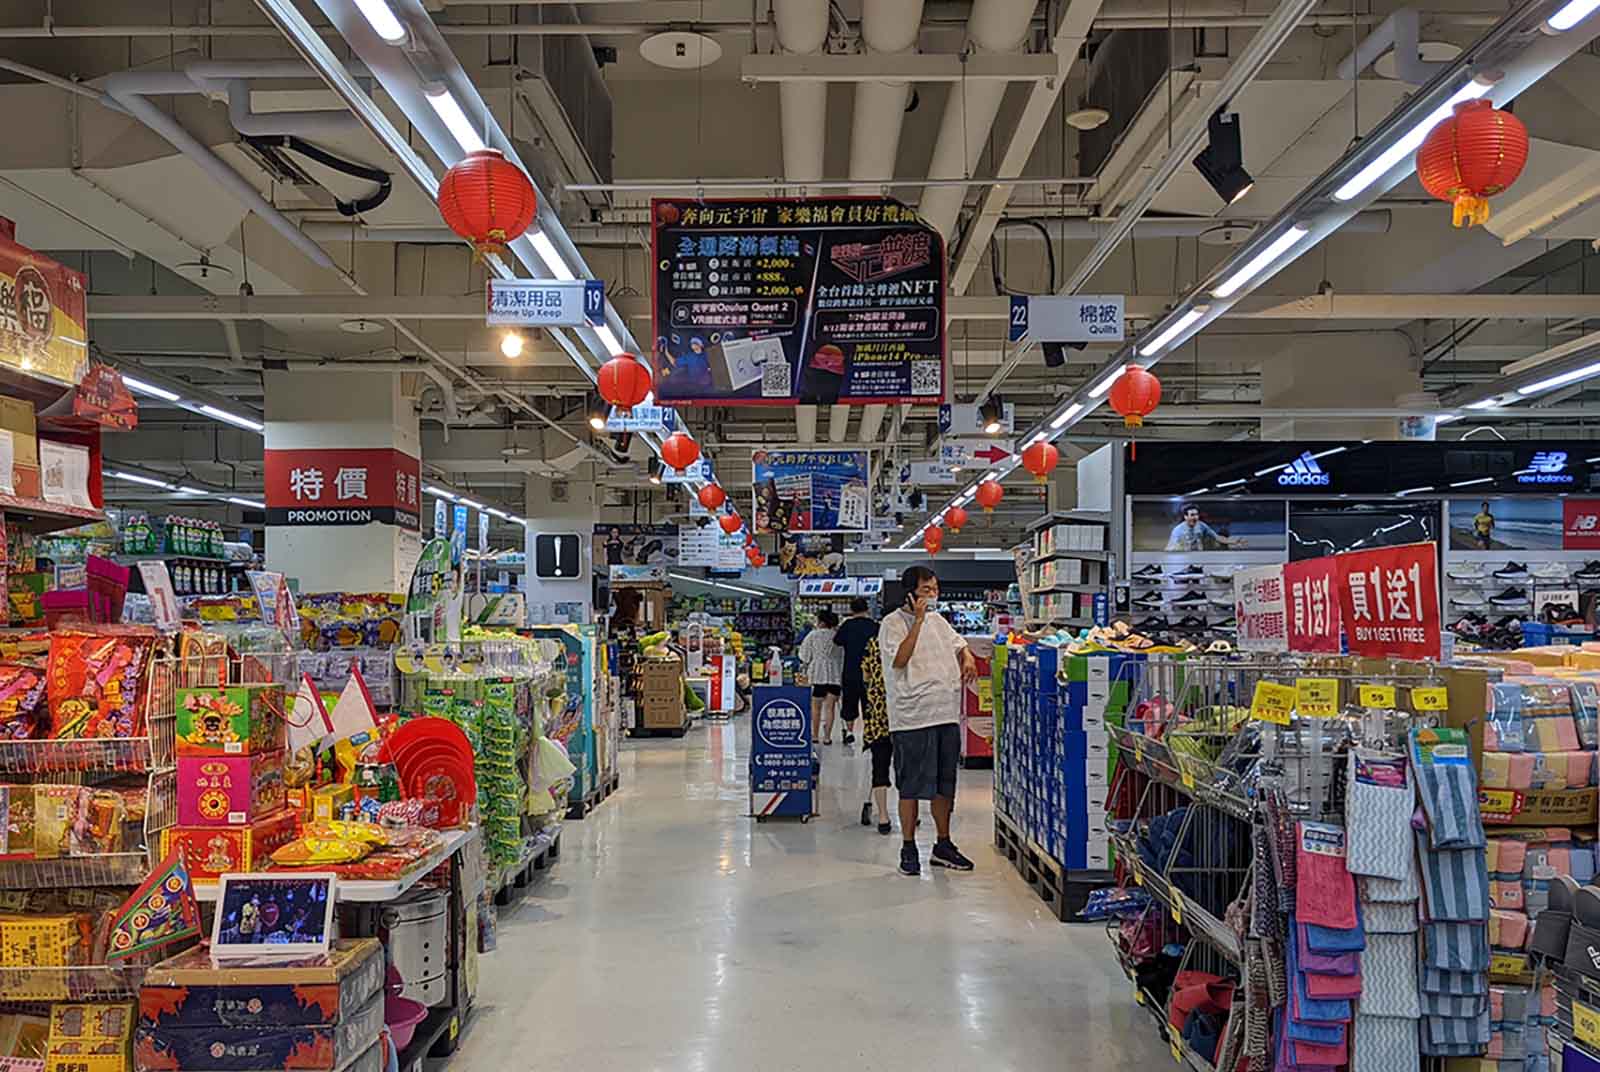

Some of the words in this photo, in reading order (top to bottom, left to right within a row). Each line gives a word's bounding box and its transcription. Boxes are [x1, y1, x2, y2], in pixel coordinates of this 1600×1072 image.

[681, 207, 768, 226] 奔向元宇宙
[491, 290, 562, 308] 清潔用品
[587, 290, 601, 311] 19
[782, 302, 789, 312] 2
[522, 309, 534, 318] Up
[537, 309, 562, 318] Keep
[1012, 306, 1027, 326] 22
[1079, 304, 1118, 324] 棉被
[1089, 325, 1118, 335] Quilts
[290, 467, 370, 502] 特價
[1278, 472, 1330, 485] adidas
[1517, 475, 1536, 483] new
[1538, 474, 1574, 483] balance
[288, 509, 372, 524] PROMOTION
[1349, 561, 1424, 623] 買1送1
[1292, 572, 1330, 637] 買1送1
[1356, 626, 1372, 641] BUY
[1378, 627, 1396, 642] GET
[1403, 627, 1426, 643] FREE
[1371, 693, 1385, 702] 59
[1424, 695, 1438, 705] 59
